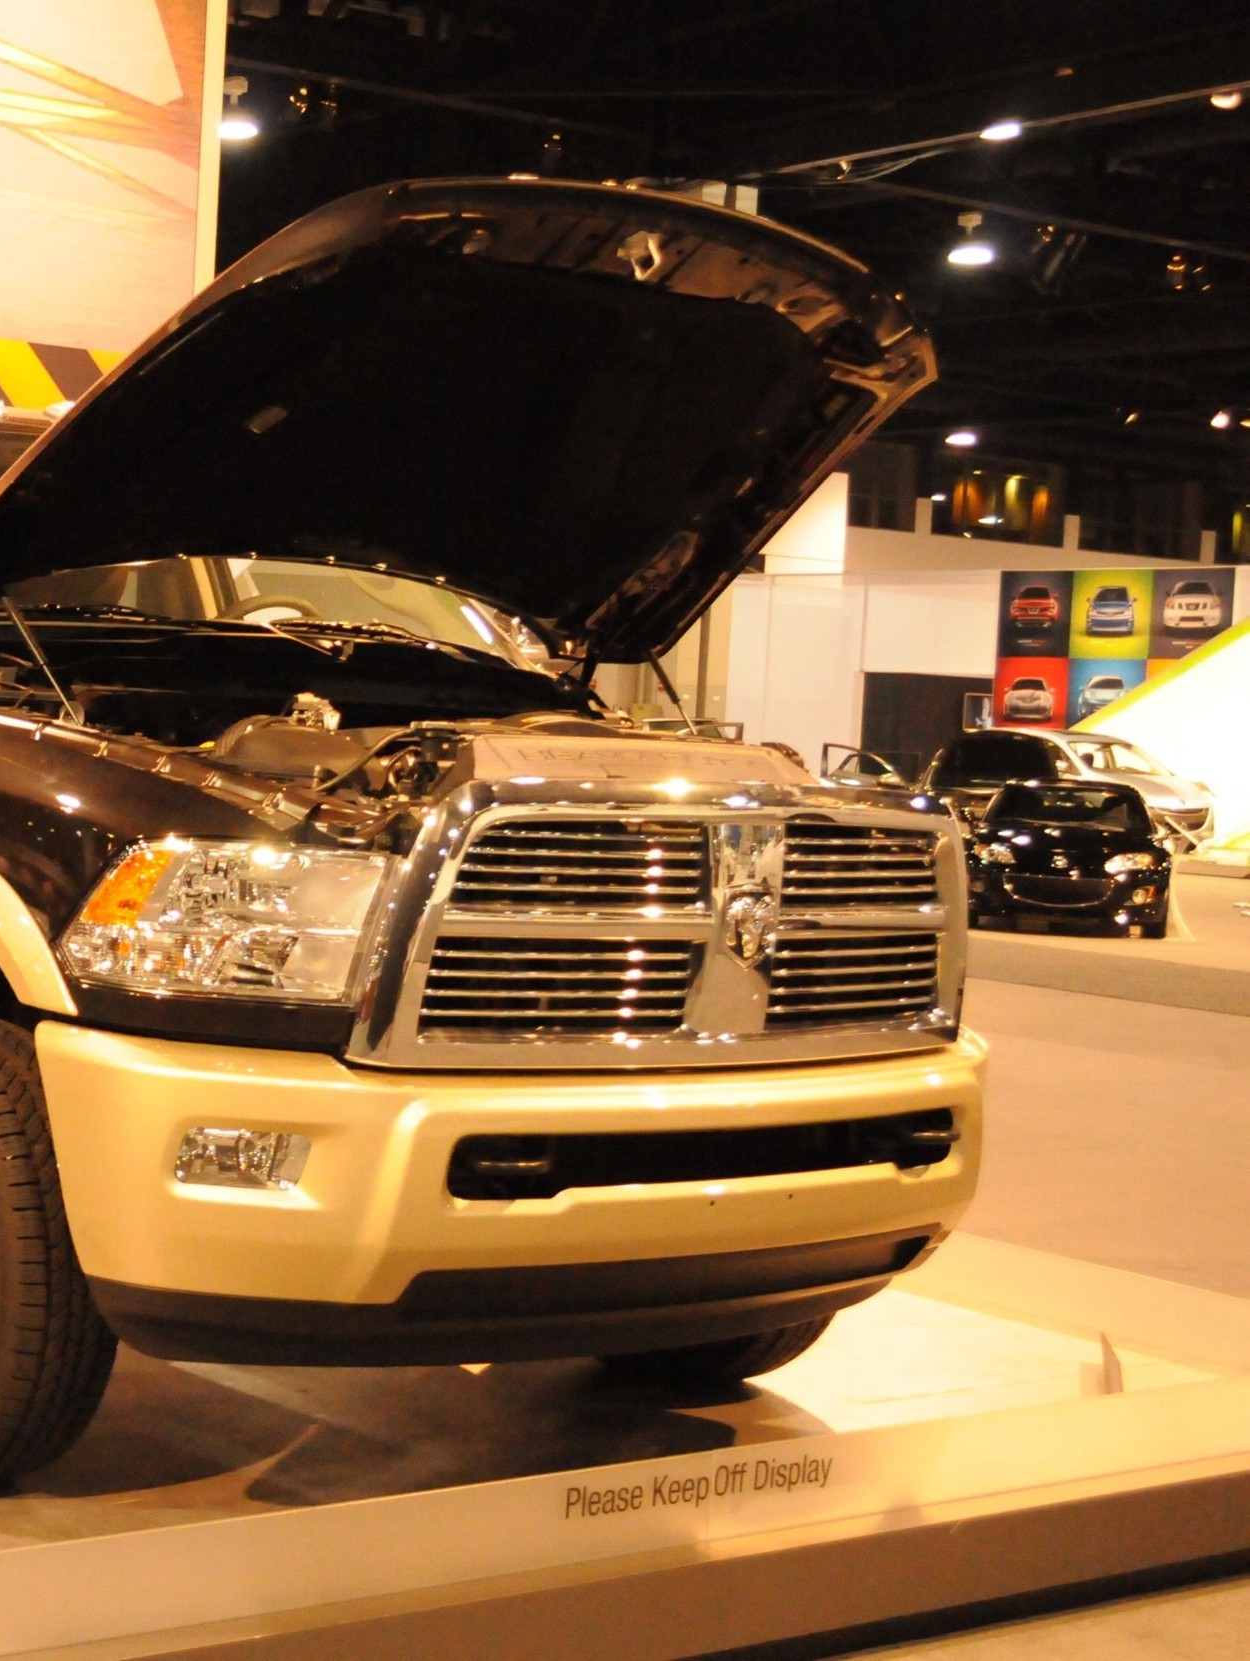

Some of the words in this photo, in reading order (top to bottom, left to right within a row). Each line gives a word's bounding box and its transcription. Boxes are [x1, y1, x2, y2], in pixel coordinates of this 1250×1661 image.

[565, 1483, 643, 1519] Please
[651, 1474, 710, 1507] Keep
[714, 1462, 748, 1497] Off
[753, 1454, 833, 1492] Display
